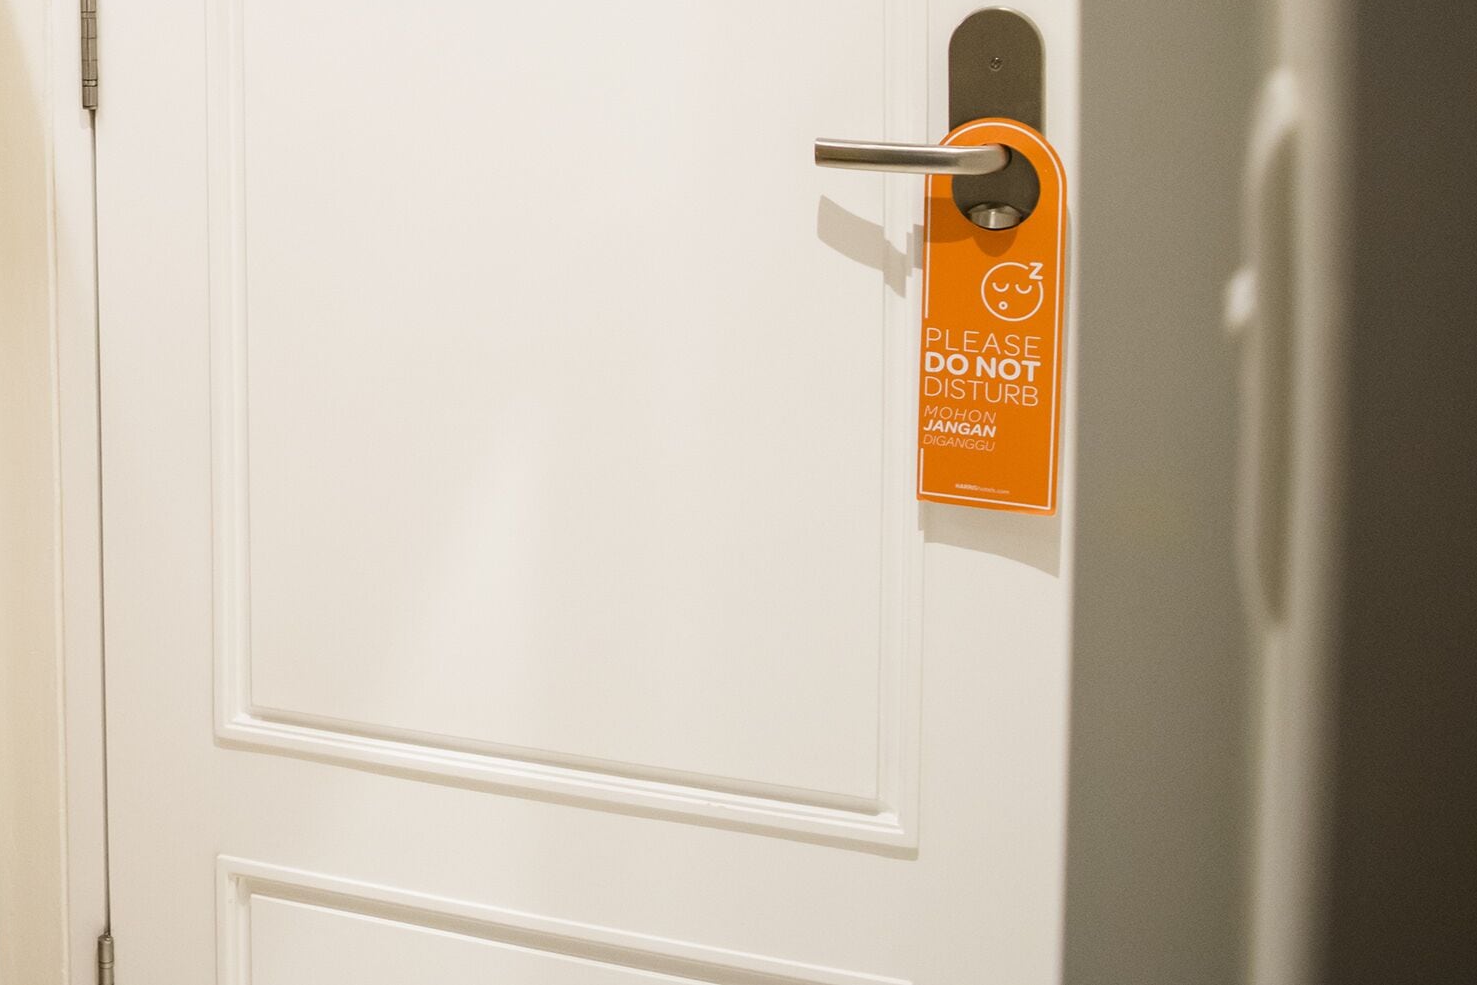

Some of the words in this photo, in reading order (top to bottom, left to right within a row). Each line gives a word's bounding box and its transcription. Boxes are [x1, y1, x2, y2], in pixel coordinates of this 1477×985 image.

[925, 327, 1041, 358] PLEASE
[924, 351, 969, 375] DO
[976, 355, 1041, 382] NOT
[924, 376, 1039, 407] DISTURB
[924, 405, 996, 424] MOHON
[923, 419, 996, 437] JANGAN
[923, 434, 996, 452] DIGANGGU
